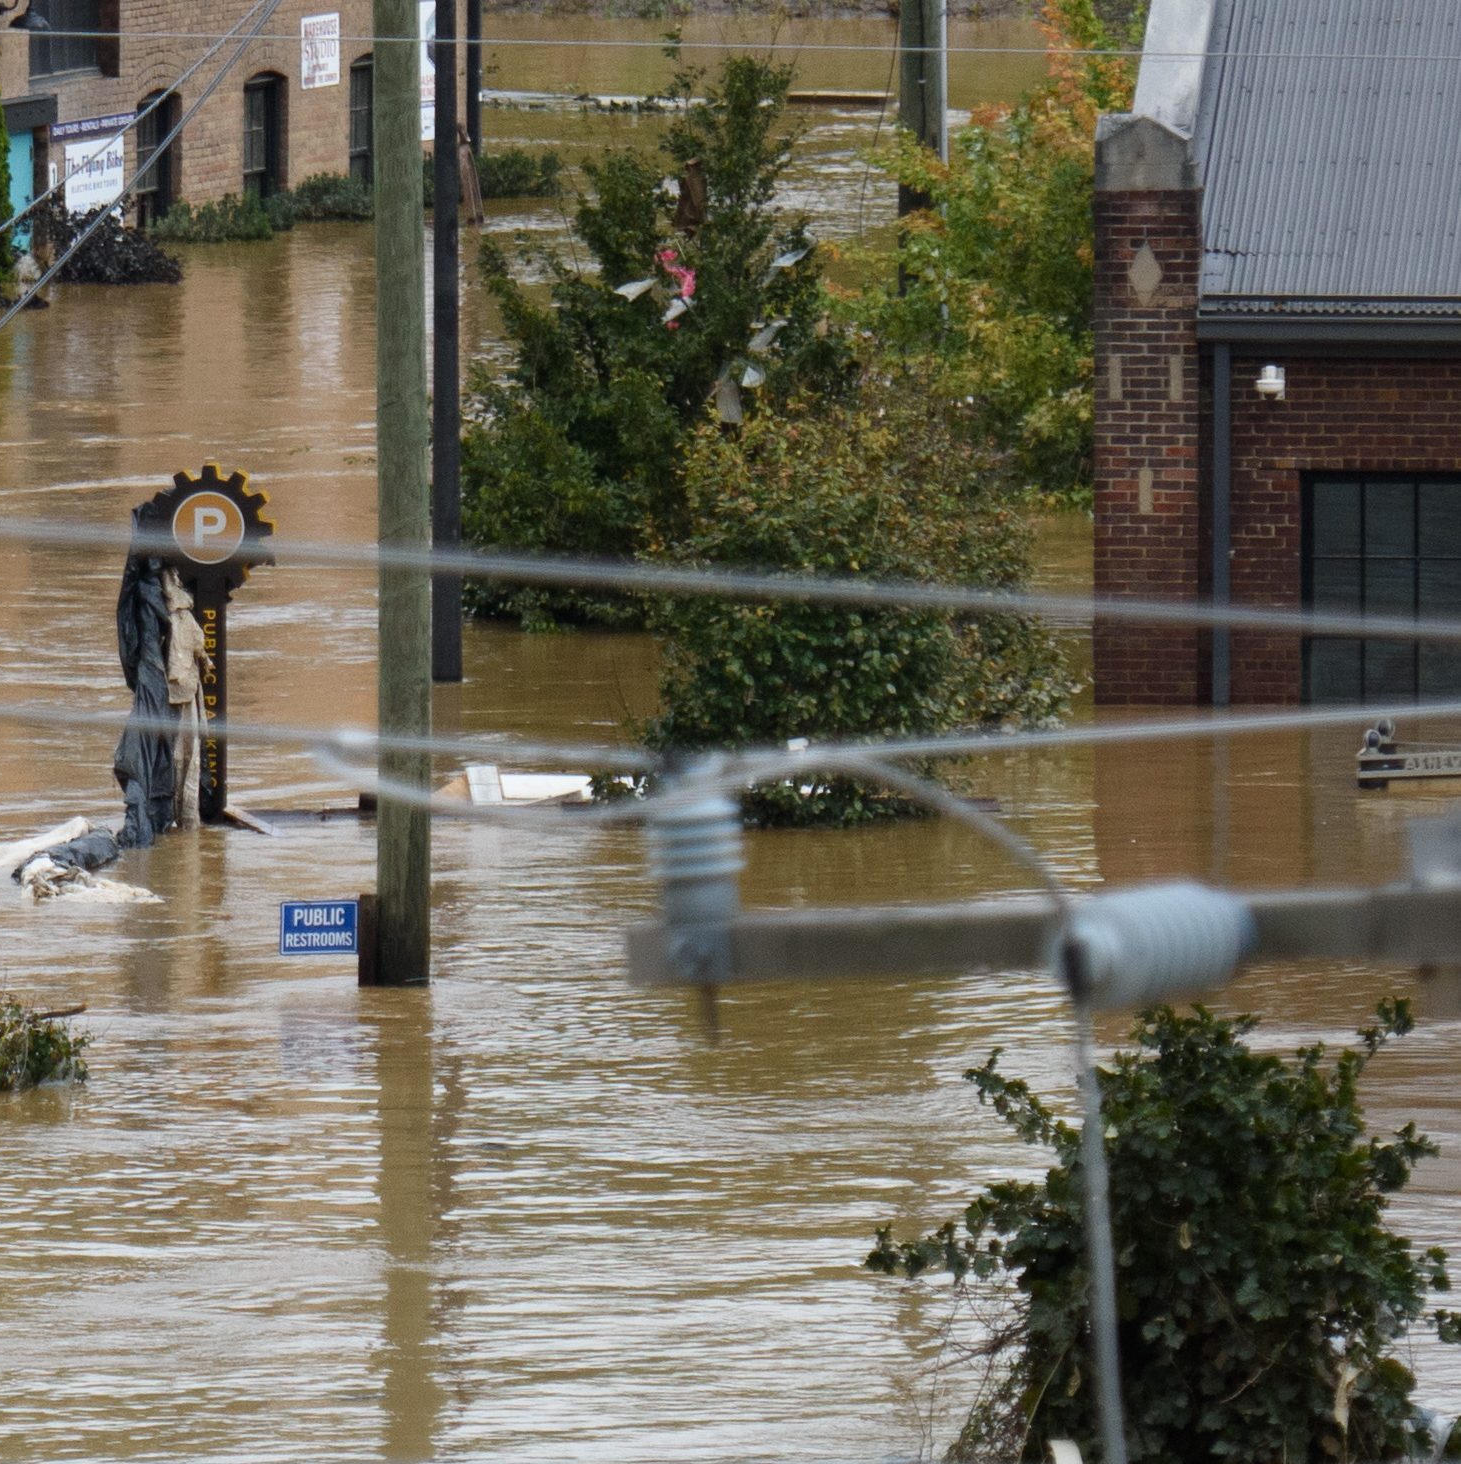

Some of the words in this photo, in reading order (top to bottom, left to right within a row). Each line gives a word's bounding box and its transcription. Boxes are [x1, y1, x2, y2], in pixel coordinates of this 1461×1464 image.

[304, 40, 336, 61] STUDIO
[107, 151, 123, 169] Bike
[194, 507, 227, 548] P
[203, 609, 217, 684] PUBC
[293, 907, 345, 927] PUBLIC
[285, 932, 353, 948] RESTROOMS
